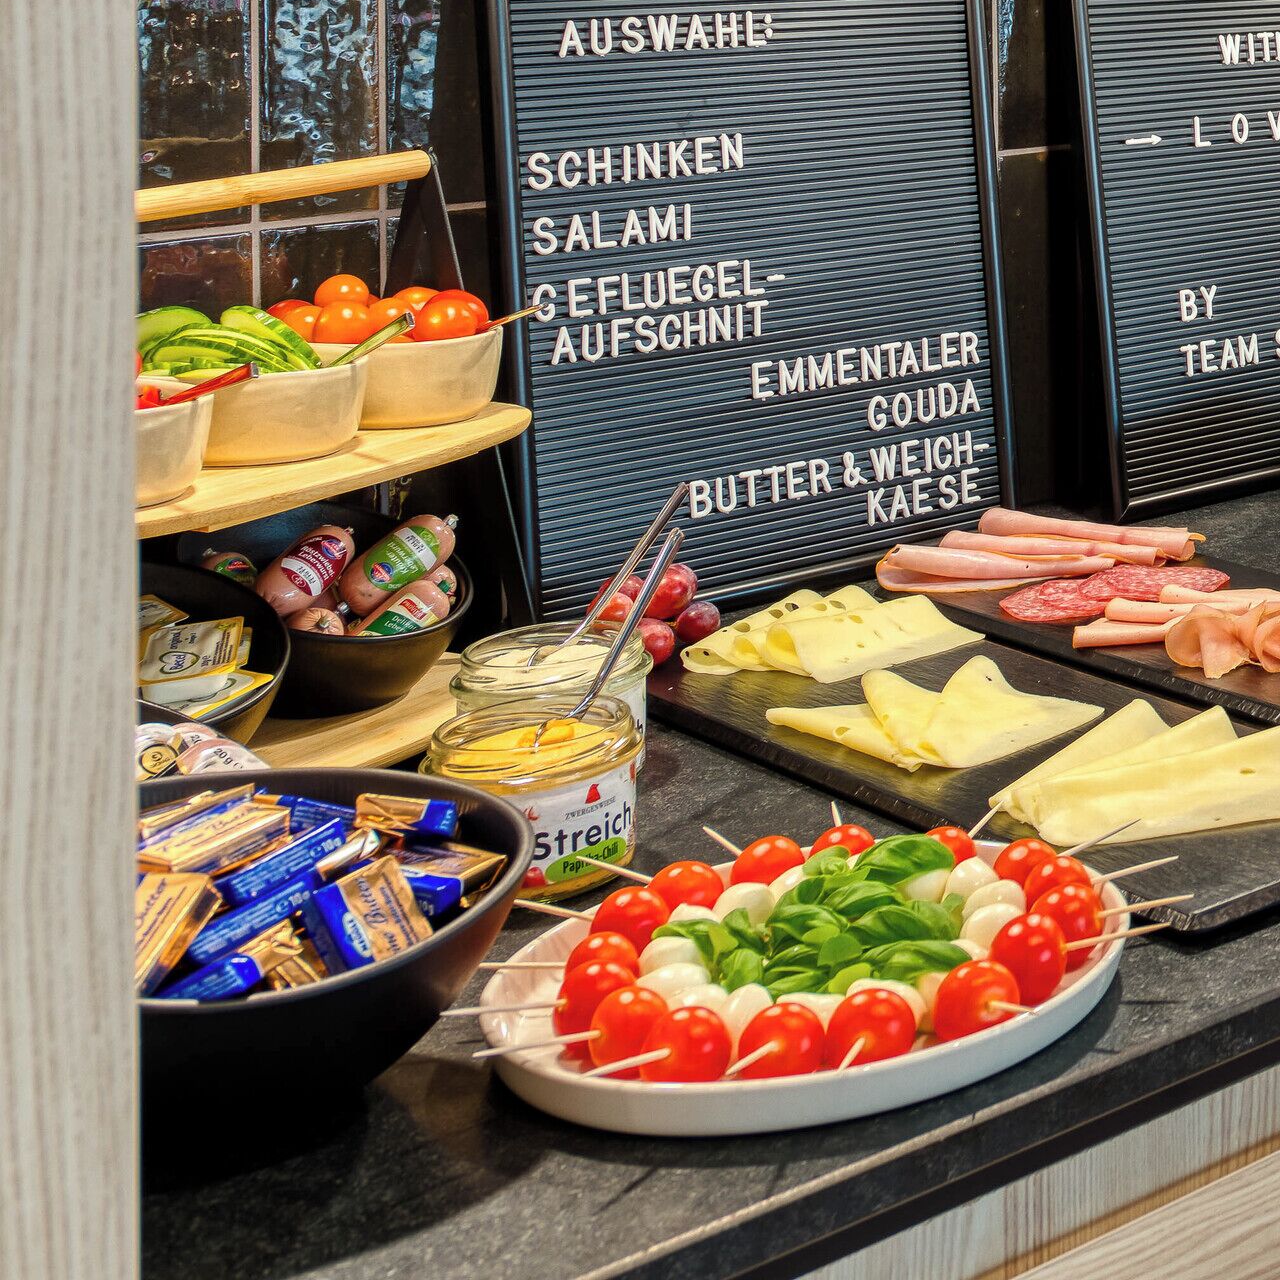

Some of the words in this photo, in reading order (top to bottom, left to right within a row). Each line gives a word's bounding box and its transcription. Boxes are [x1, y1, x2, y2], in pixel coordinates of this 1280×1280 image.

[557, 10, 774, 59] AUSWAHL:
[526, 132, 746, 192] SCHINKEN
[531, 202, 693, 256] SALAMI
[531, 258, 786, 323] GEFLUEGEL-
[1178, 284, 1218, 324] BY
[550, 299, 770, 367] AUFSCHNIT
[1179, 333, 1260, 378] TEAM
[749, 330, 982, 402] EMMENTALER
[866, 378, 982, 433] GOUDA
[688, 458, 831, 520] BUTTER
[841, 451, 868, 489] &
[868, 429, 991, 484] WEICH-
[866, 466, 982, 528] KAESE
[533, 800, 632, 861] Streich
[564, 795, 617, 821] ZWERGENWIESE
